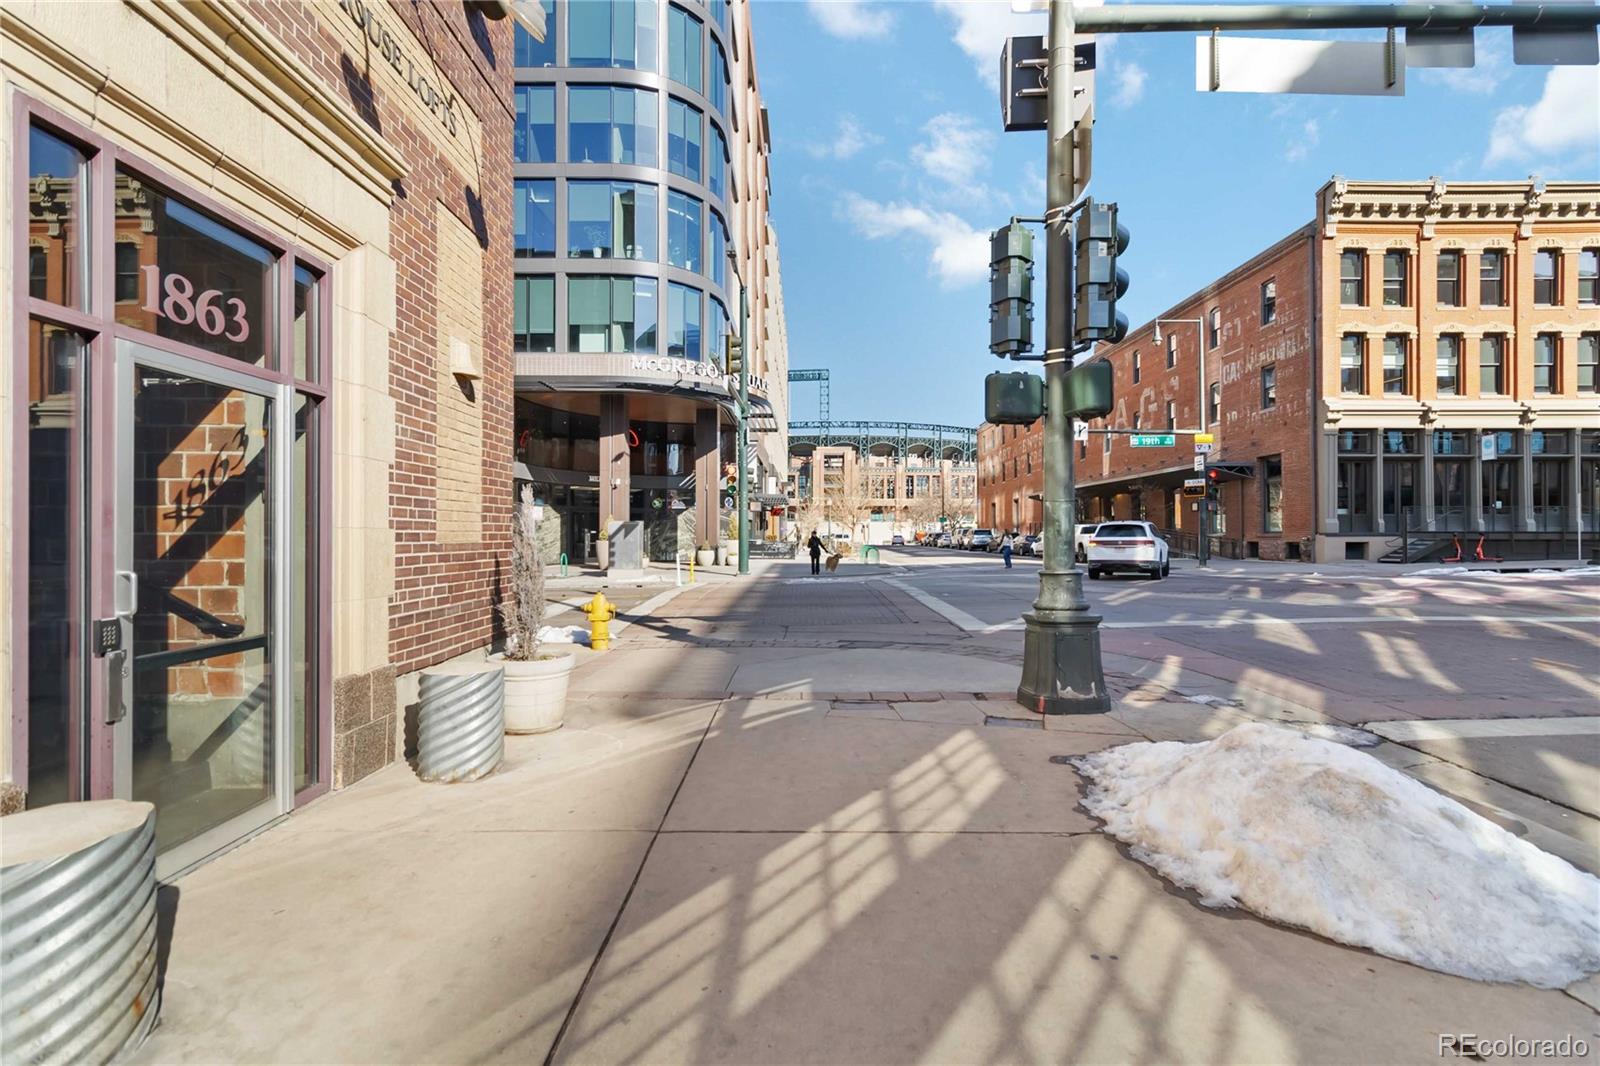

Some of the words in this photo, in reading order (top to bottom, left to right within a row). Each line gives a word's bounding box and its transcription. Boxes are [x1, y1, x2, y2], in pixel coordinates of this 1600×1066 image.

[339, 0, 404, 77] OUSE
[407, 60, 457, 138] LOFTS
[141, 264, 250, 343] 1863
[1141, 436, 1160, 445] 19th
